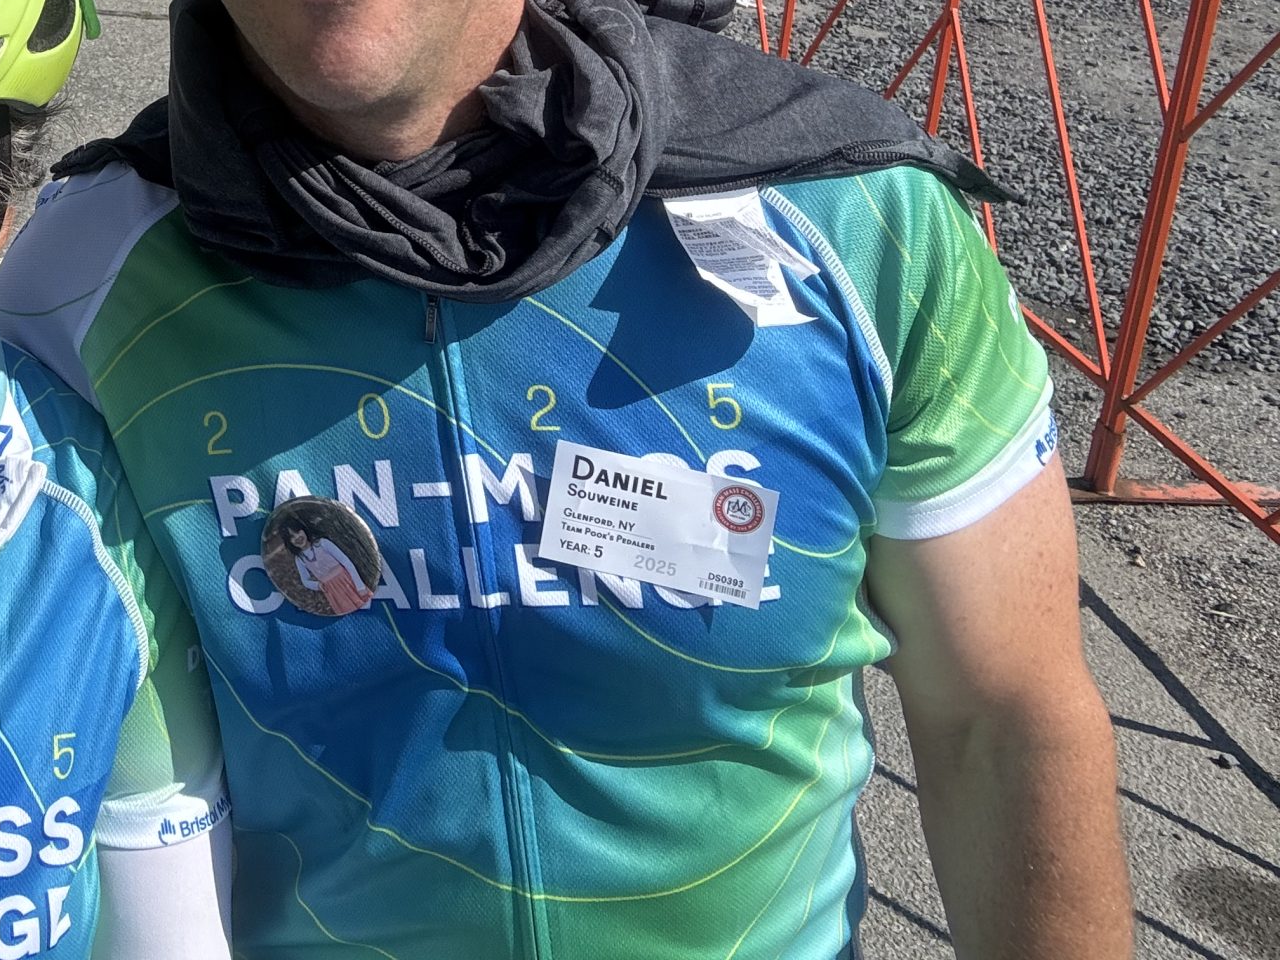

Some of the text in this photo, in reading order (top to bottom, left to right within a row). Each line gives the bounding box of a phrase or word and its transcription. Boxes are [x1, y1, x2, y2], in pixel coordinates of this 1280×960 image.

[203, 410, 233, 455] 2
[526, 385, 561, 431] 2
[707, 382, 743, 430] 5
[572, 455, 668, 500] DANIEL
[567, 483, 640, 512] SOUWEINE
[563, 507, 636, 532] GLENFORD, NY
[559, 539, 604, 559] YEAR: 5
[561, 521, 655, 551] TEAM POOK'S PEDALERS
[634, 554, 678, 577] 2025
[707, 572, 744, 589] DS0393
[53, 733, 77, 780] 5
[179, 806, 220, 838] Bristol
